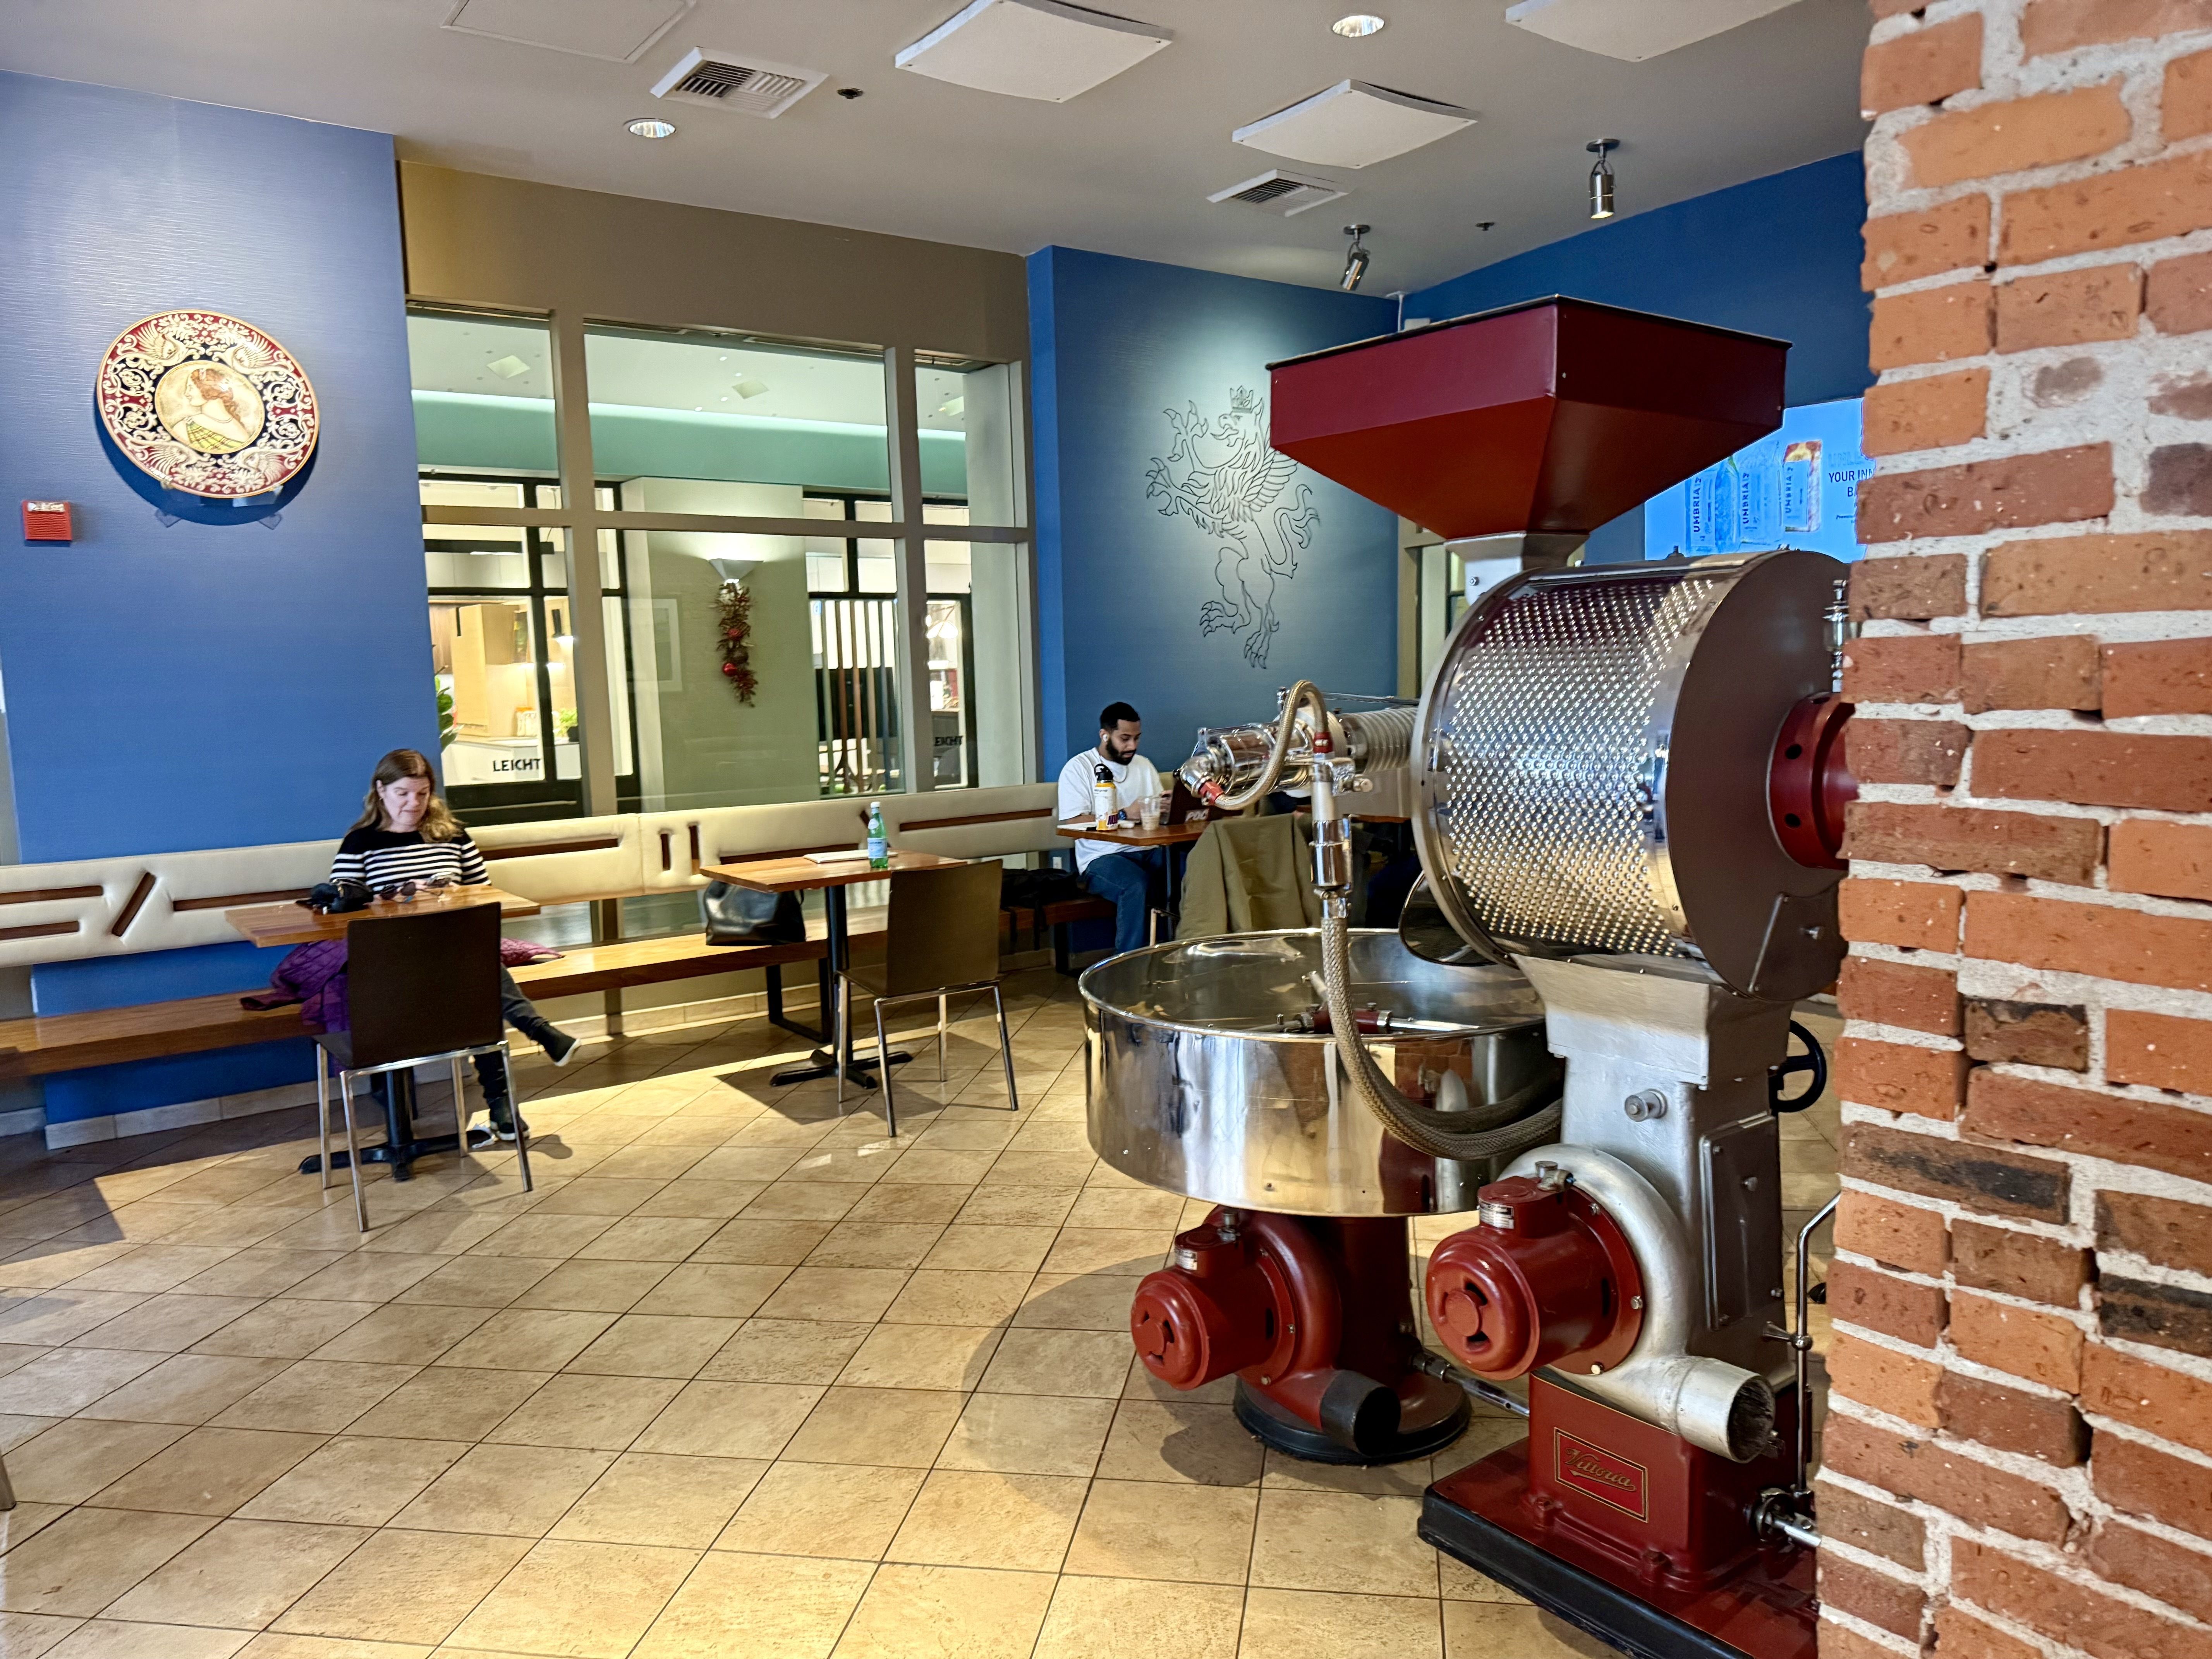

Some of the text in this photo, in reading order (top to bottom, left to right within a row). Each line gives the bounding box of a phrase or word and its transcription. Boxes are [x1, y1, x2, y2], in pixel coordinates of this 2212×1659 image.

[1828, 470, 1855, 483] YOUR
[1693, 487, 1701, 532] UMBRIA
[493, 757, 542, 772] LEICHT
[1565, 1448, 1637, 1492] Vittoria
